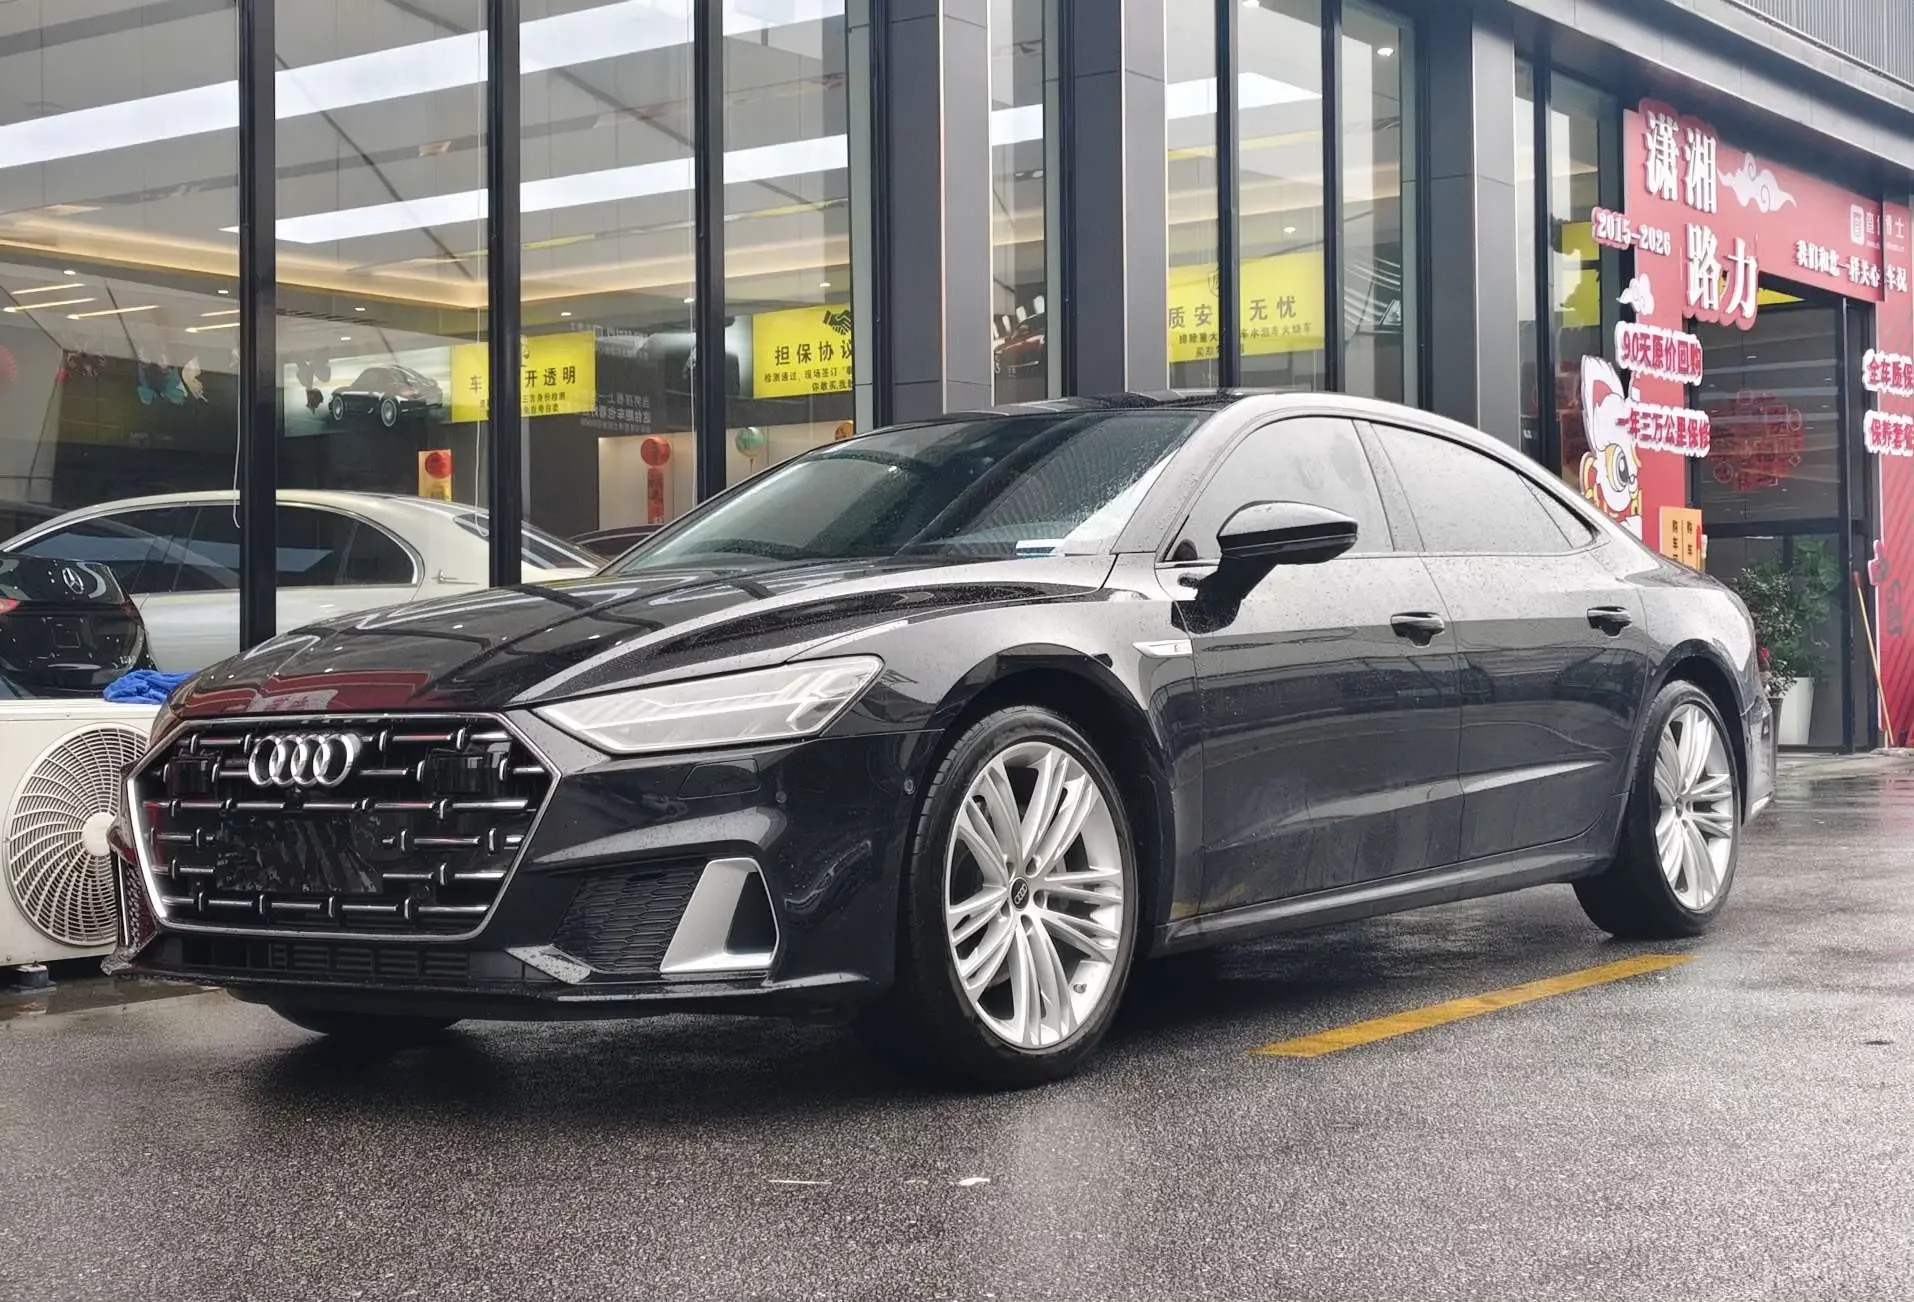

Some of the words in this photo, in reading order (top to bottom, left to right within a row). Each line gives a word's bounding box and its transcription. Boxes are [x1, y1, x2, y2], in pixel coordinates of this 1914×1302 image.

[1645, 110, 1718, 214] 潇湘
[1686, 223, 1759, 319] 路力
[1621, 330, 1702, 378] 90天原价回购
[1615, 408, 1710, 449] 一年三万公里保修
